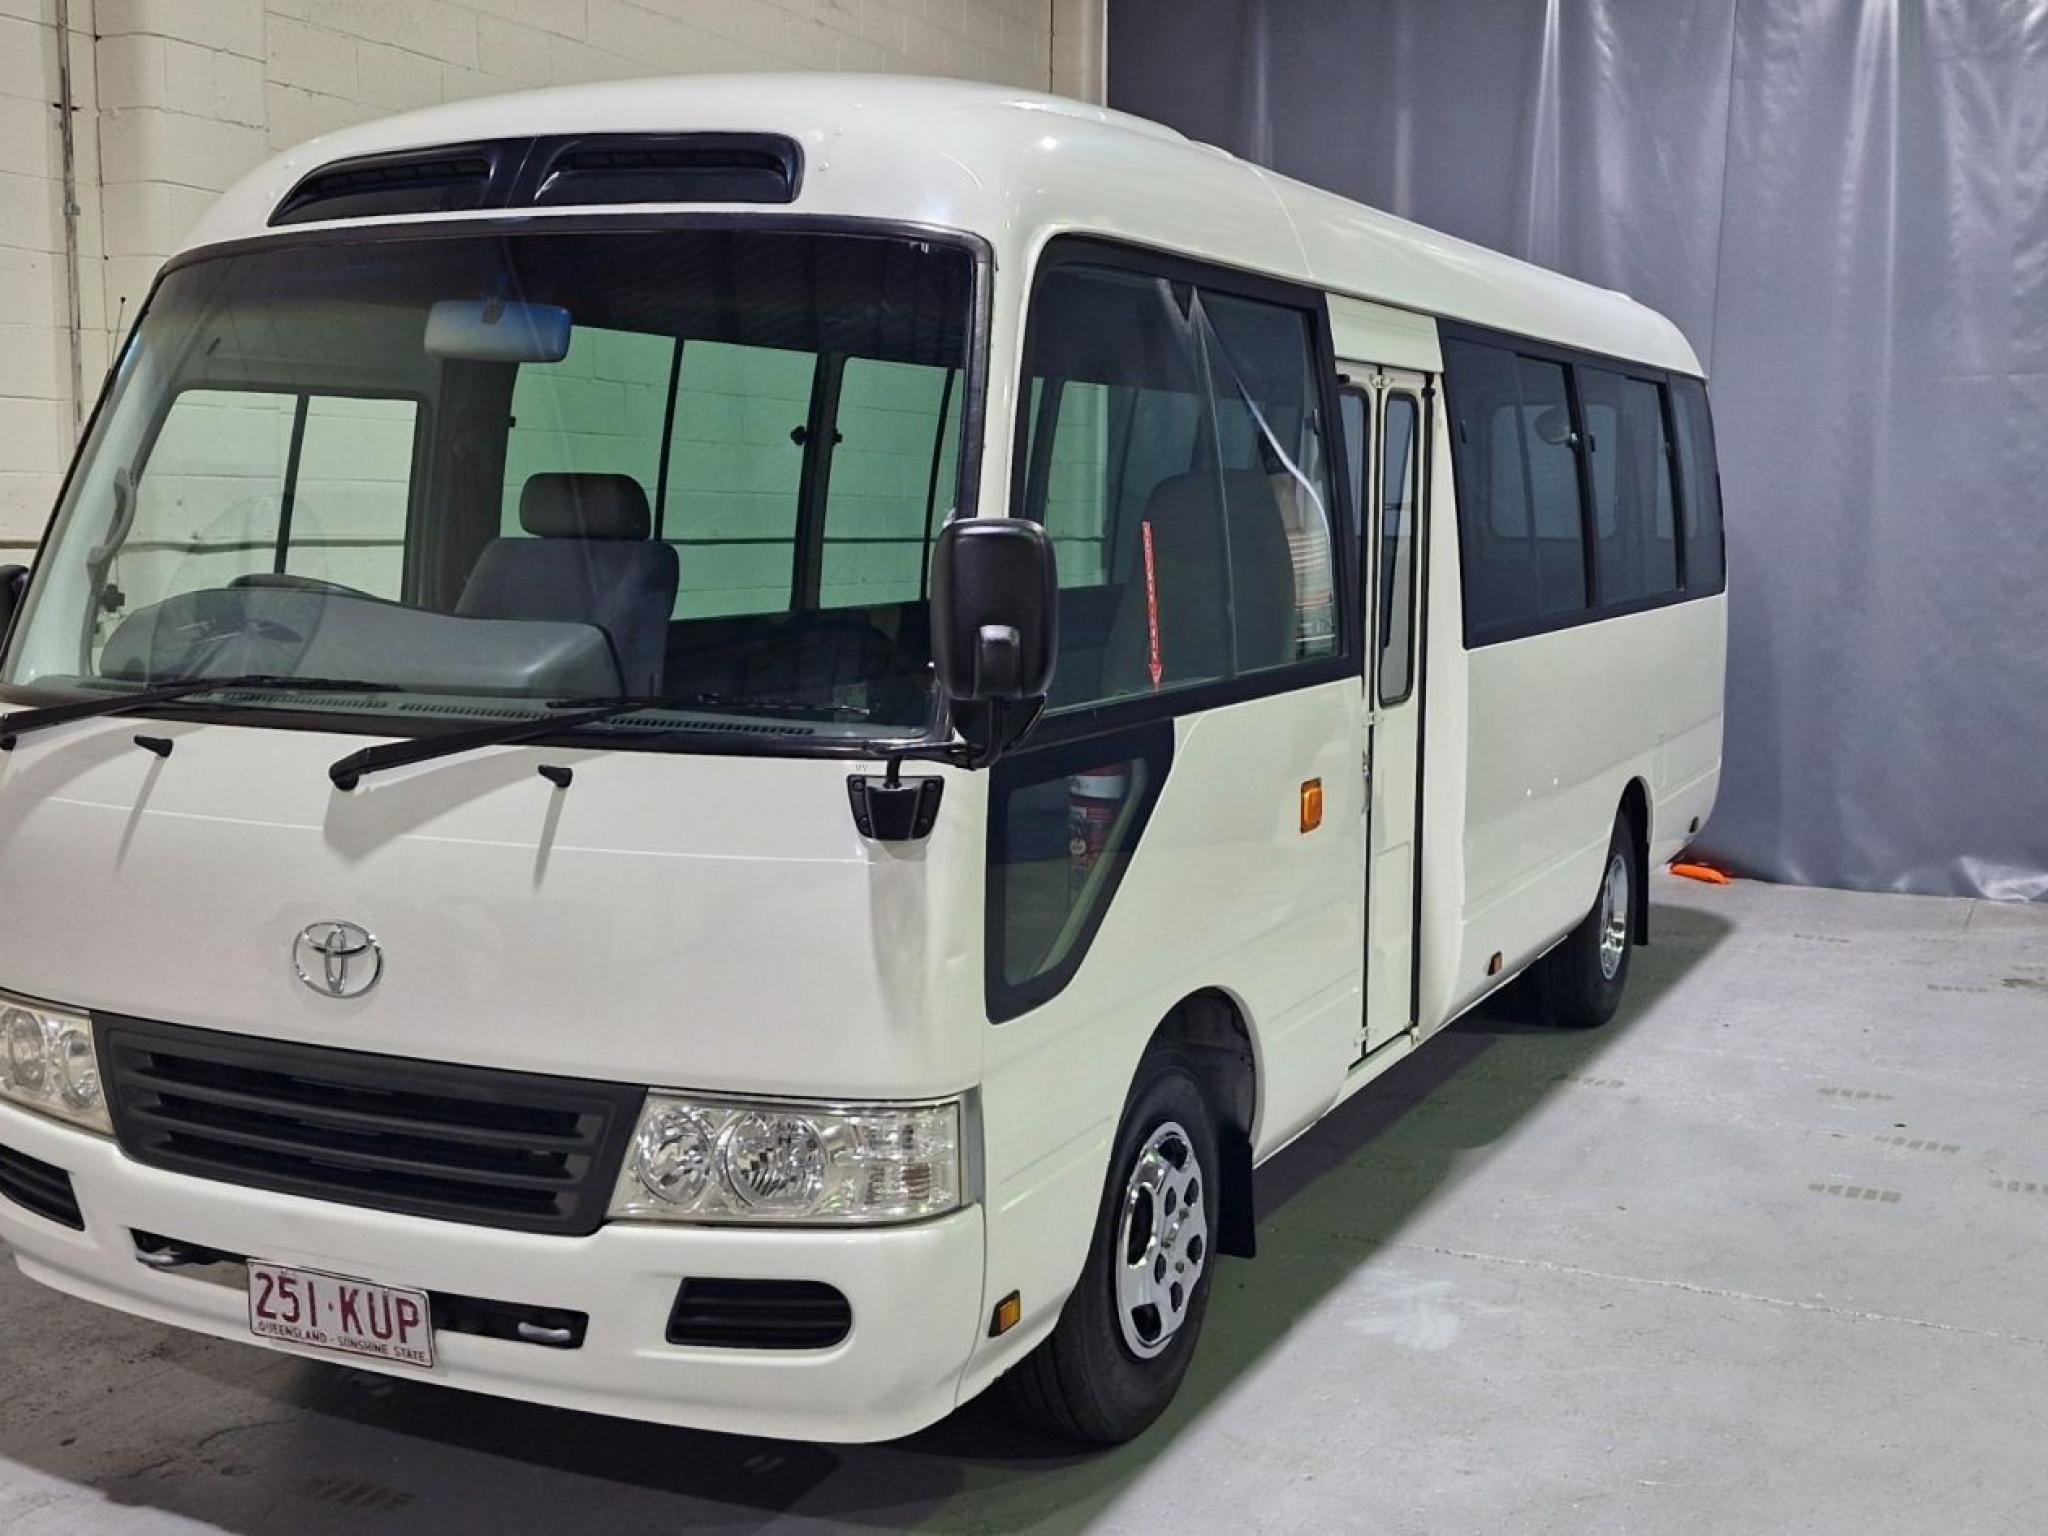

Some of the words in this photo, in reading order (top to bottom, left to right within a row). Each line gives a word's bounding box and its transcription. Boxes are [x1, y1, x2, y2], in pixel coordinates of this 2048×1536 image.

[257, 1321, 328, 1343] QUEENSLAND
[338, 1335, 389, 1355] SUNSHINE
[393, 1345, 426, 1363] STATE
